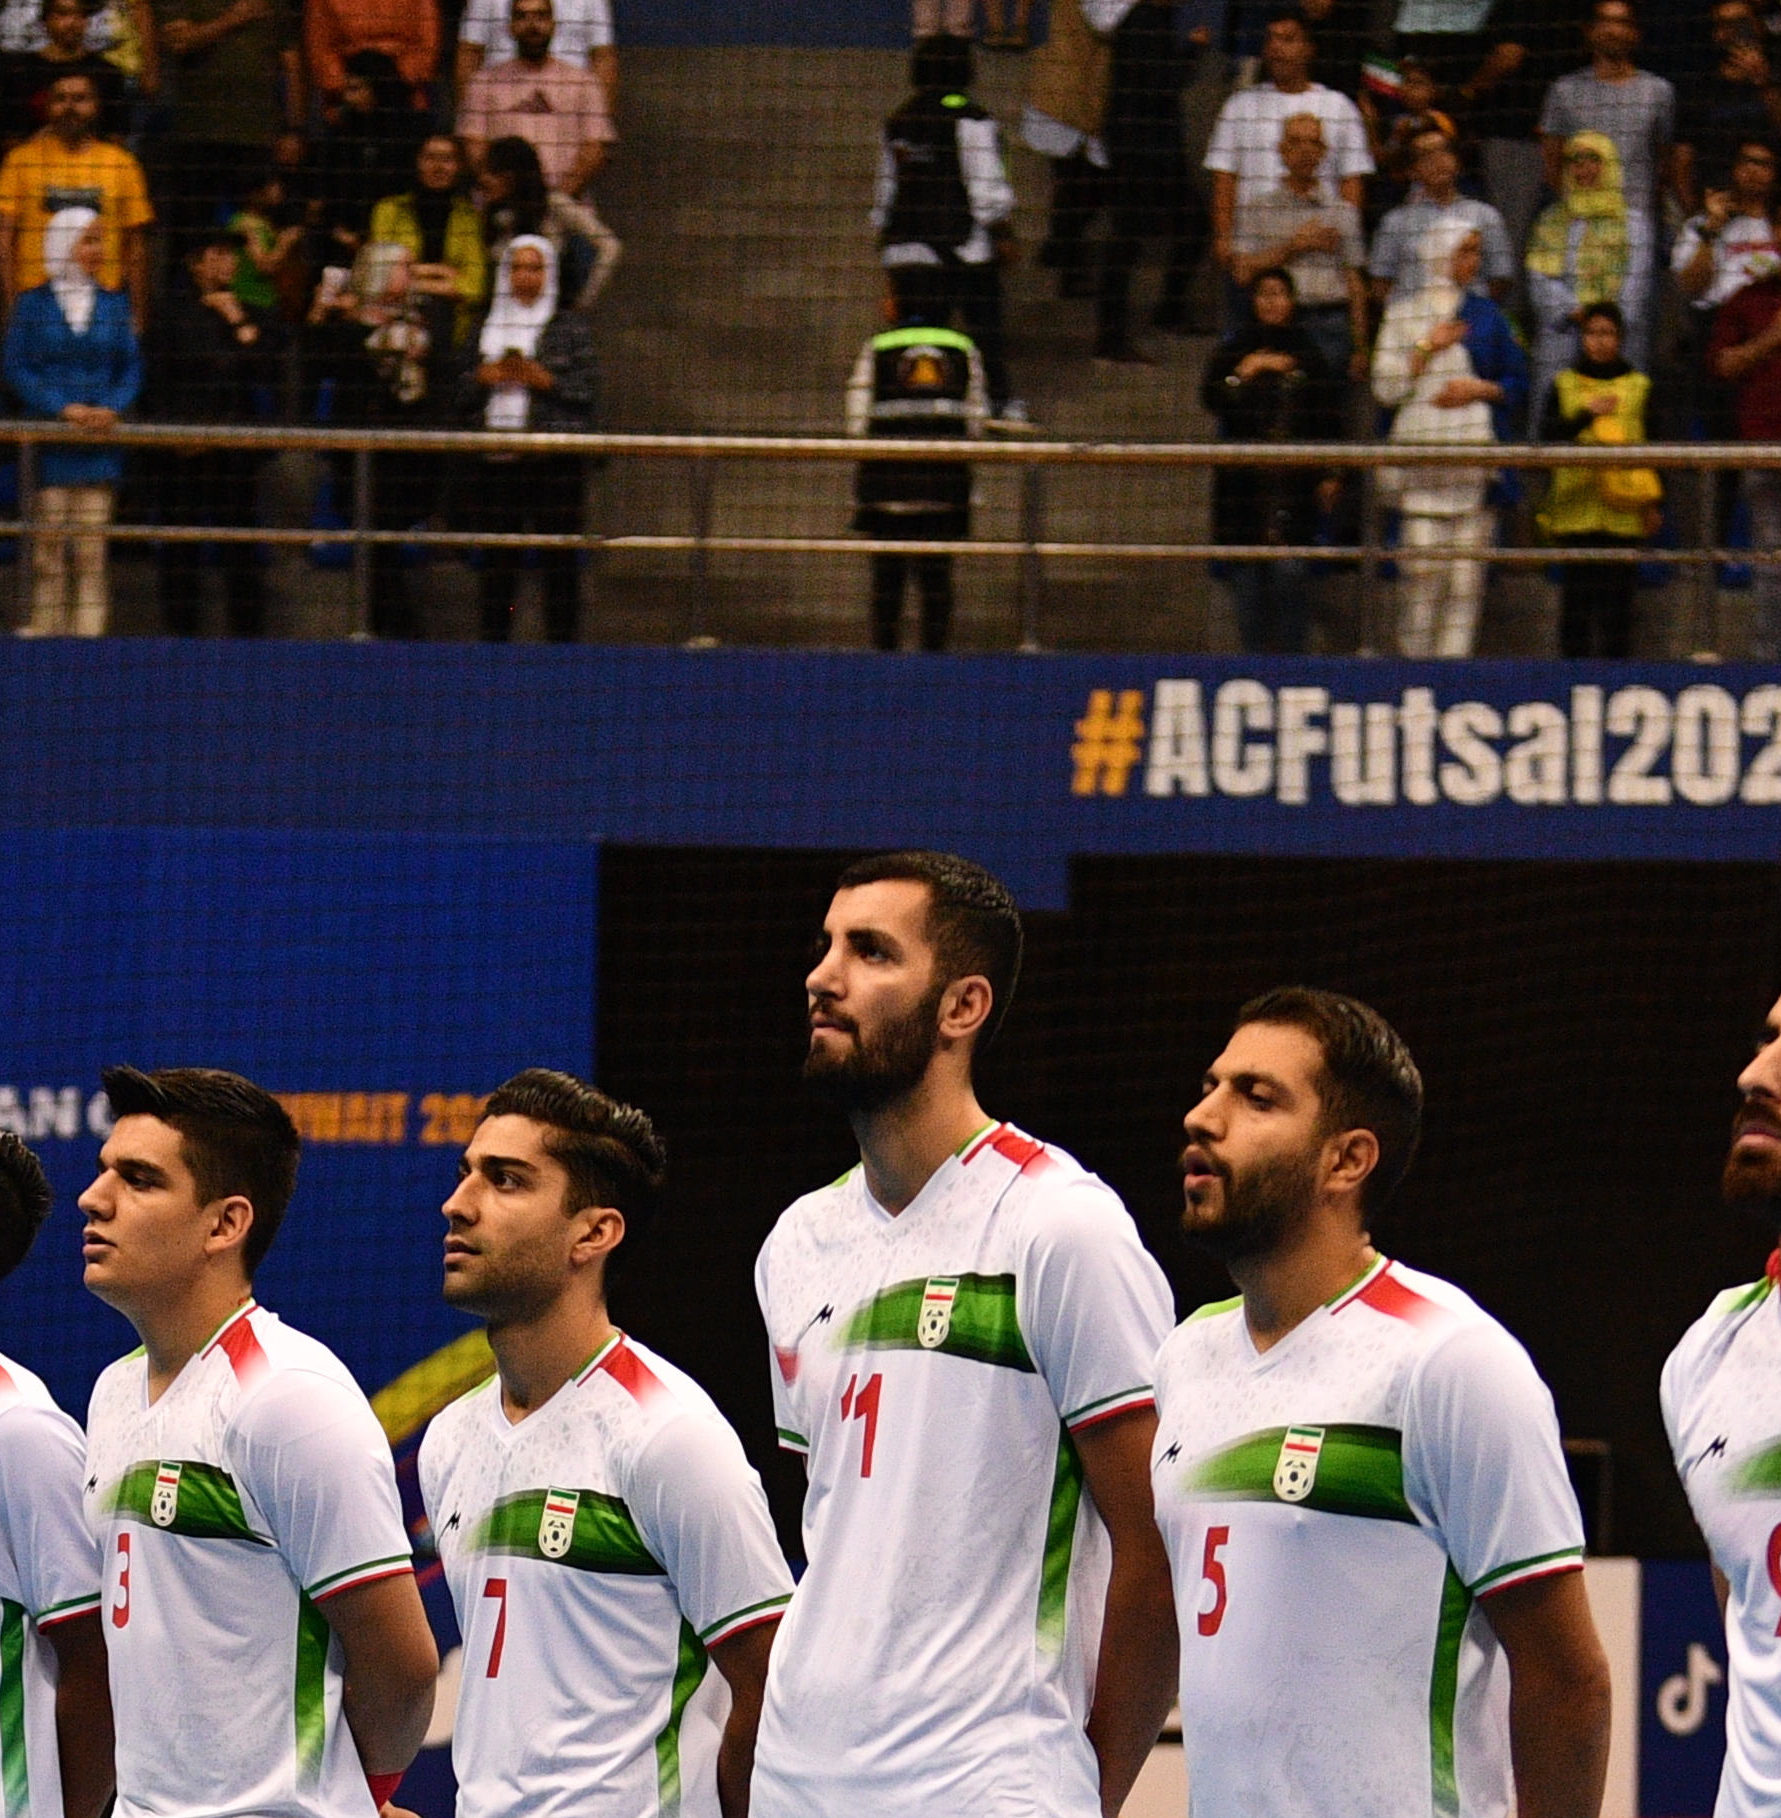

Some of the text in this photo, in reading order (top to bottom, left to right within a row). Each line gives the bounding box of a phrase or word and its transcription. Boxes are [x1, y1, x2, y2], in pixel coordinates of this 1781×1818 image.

[111, 1532, 131, 1630] 3
[482, 1577, 509, 1679] 7
[1197, 1525, 1231, 1637] 5
